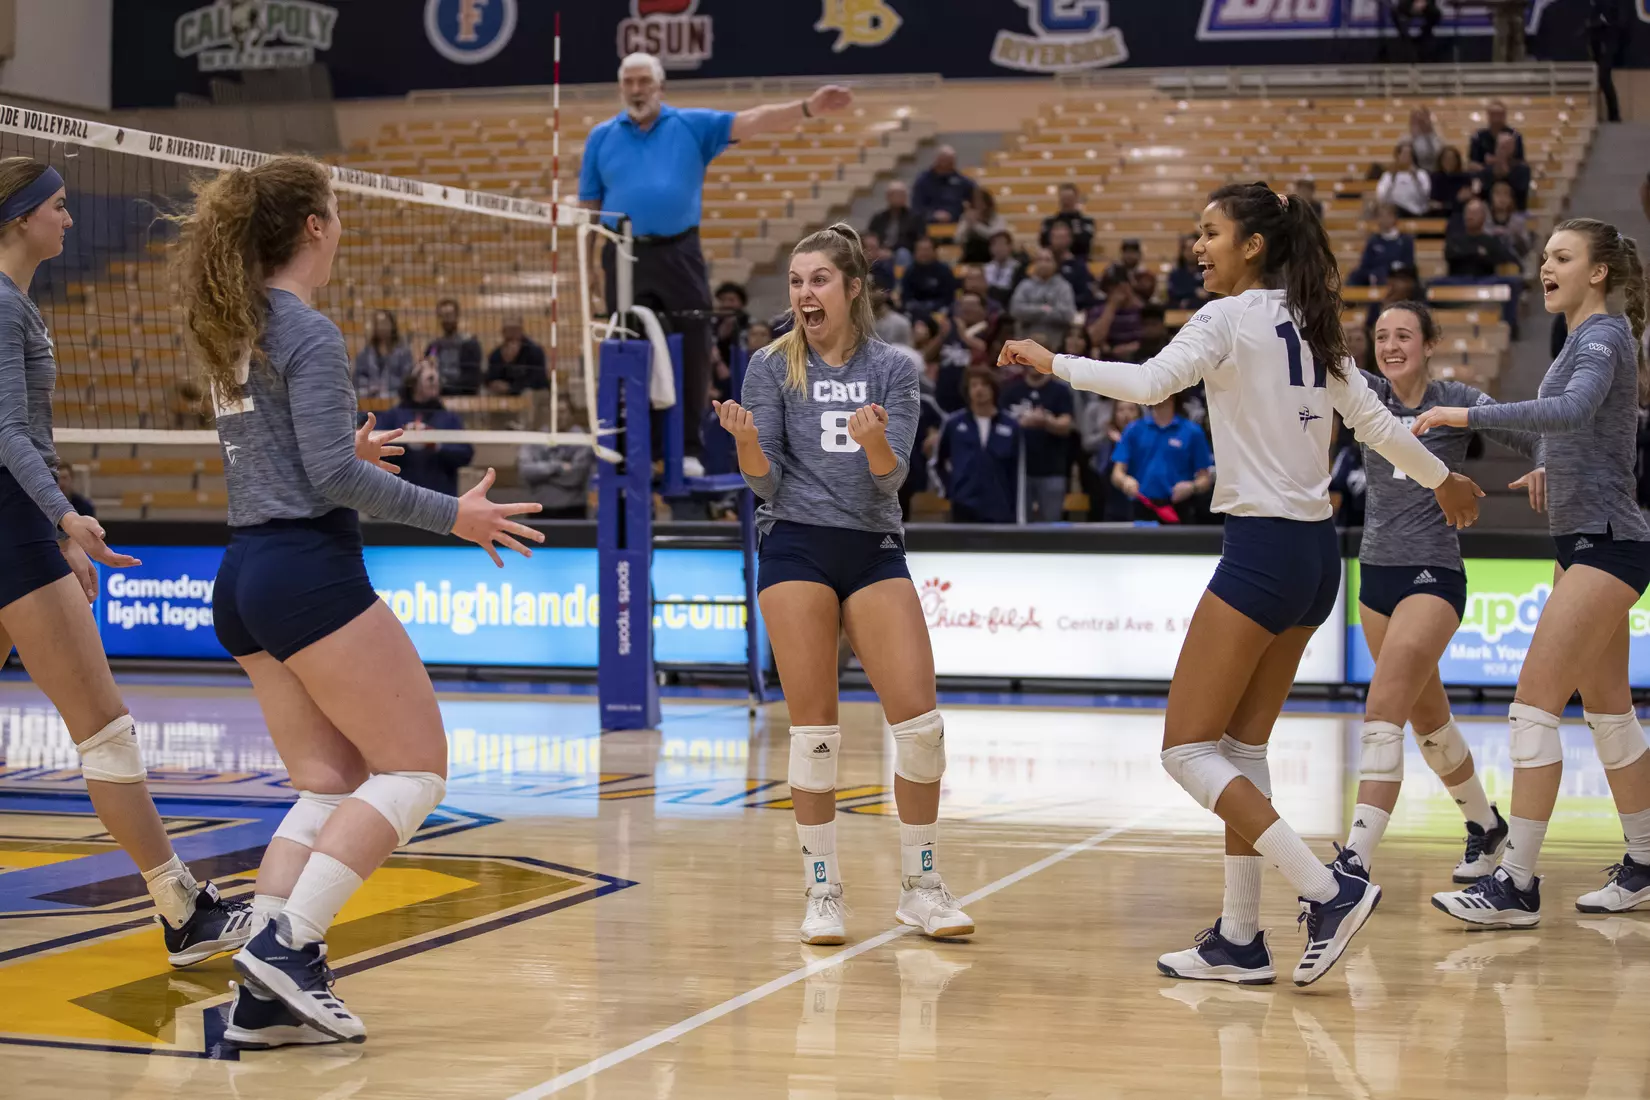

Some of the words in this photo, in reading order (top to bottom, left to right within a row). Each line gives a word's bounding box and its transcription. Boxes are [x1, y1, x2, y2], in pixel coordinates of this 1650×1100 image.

[180, 8, 229, 51] CAL
[267, 3, 331, 44] POLY
[624, 21, 706, 55] CSUN
[0, 105, 20, 127] IDE
[24, 110, 88, 139] VOLLEYBALL
[149, 134, 163, 152] UC
[166, 138, 216, 162] RIVERSIDE
[1588, 342, 1613, 357] WAC
[812, 380, 867, 403] CBU
[820, 411, 862, 452] 8
[107, 573, 216, 604] Gameday
[107, 600, 160, 630] light
[161, 600, 214, 631] lage
[1057, 616, 1118, 632] Central
[1124, 616, 1158, 632] Ave.
[1450, 645, 1492, 660] Mark
